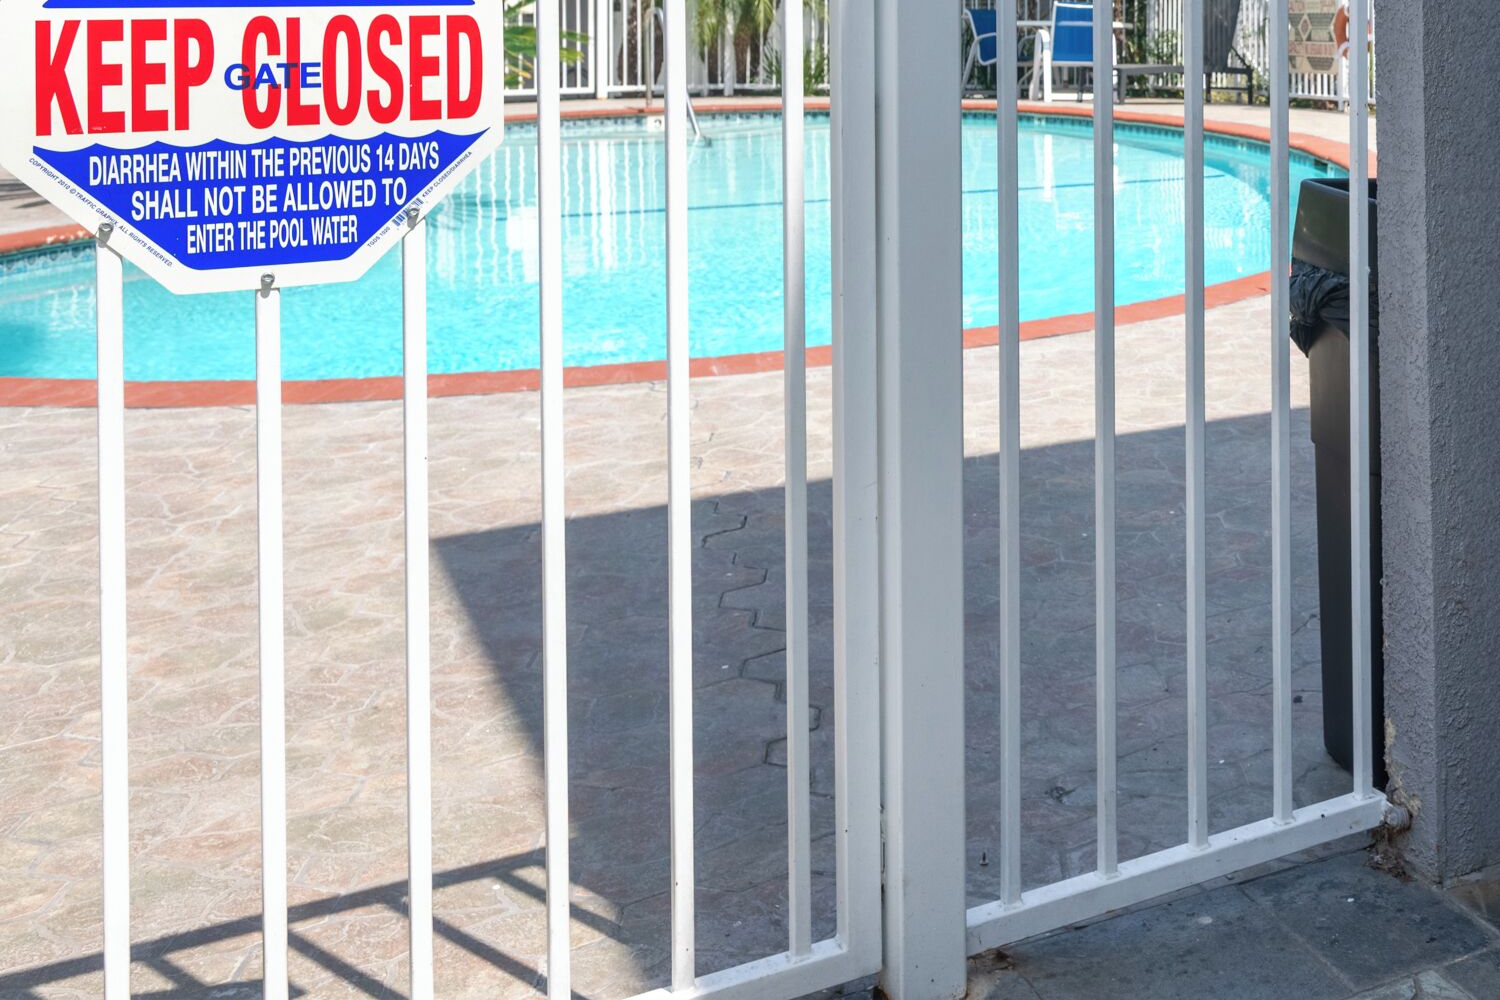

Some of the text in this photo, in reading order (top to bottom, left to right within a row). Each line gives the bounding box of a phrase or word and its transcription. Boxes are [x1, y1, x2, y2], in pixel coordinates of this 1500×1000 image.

[35, 14, 483, 136] KEEP CLOSED
[224, 62, 322, 90] GATE
[89, 141, 439, 186] DIARRHEA WITHIN THE PREVIOUS 14 DAYS
[28, 157, 59, 184] COPYRIGHT
[74, 191, 97, 210] TRAFFIC
[118, 225, 129, 235] ALL
[128, 232, 147, 248] RIGHTS
[131, 177, 407, 221] SHALL NOT BE ALLOWED TO
[187, 214, 358, 254] ENTER THE POOL WATER
